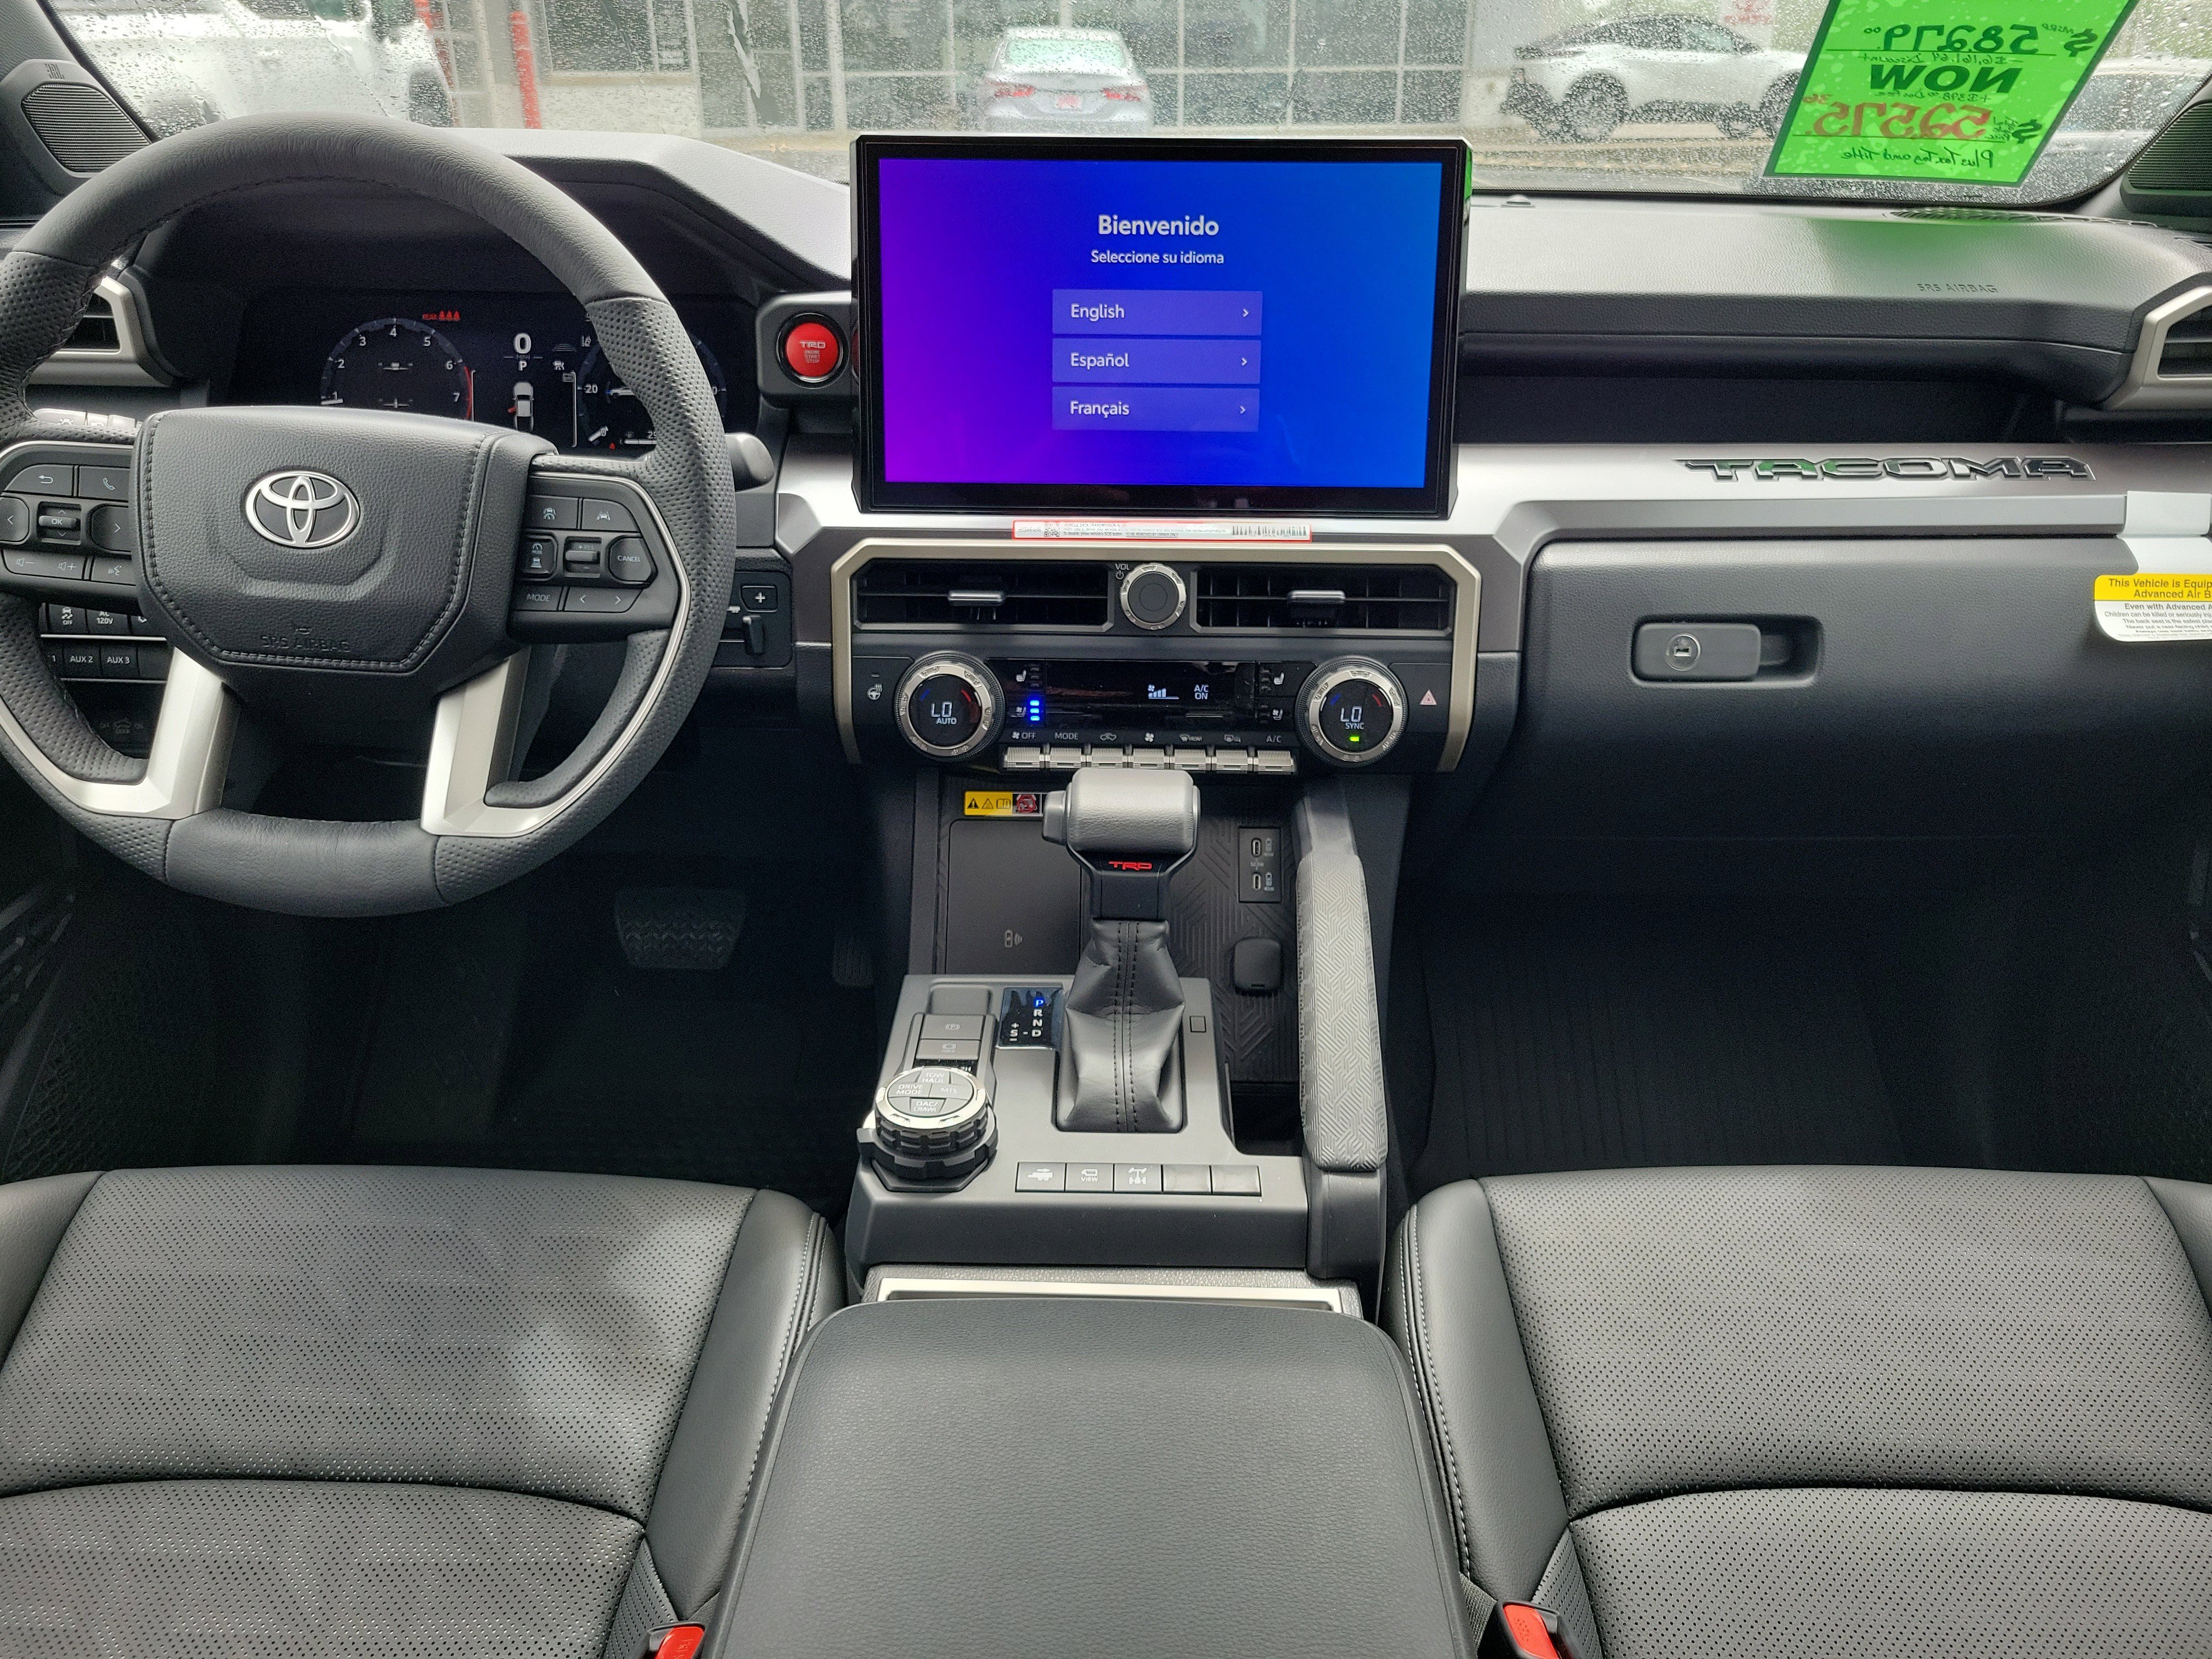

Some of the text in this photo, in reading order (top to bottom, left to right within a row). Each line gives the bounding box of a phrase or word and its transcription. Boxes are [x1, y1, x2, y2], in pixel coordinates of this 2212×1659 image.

[1098, 214, 1220, 236] Bienvenido
[1091, 250, 1224, 264] Seleccione su idioma
[1917, 284, 1999, 292] SRS AIRBAG
[1070, 303, 1125, 322] English
[390, 328, 397, 337] 4
[359, 336, 366, 346] 3
[423, 336, 431, 346] 5
[514, 332, 532, 354] 0
[799, 341, 826, 349] TRD
[337, 359, 345, 369] 2
[445, 360, 454, 370] 6
[518, 360, 527, 371] P
[1070, 352, 1130, 370] Español
[453, 392, 460, 402] 7
[1070, 400, 1130, 419] Français
[1673, 457, 2097, 482] TACOMA
[2108, 578, 2130, 587] This
[2134, 579, 2169, 588] Vehicle
[2172, 579, 2181, 588] is
[527, 594, 551, 602] MODE
[2134, 589, 2183, 598] Advanced
[2187, 590, 2201, 599] Air
[1194, 684, 1209, 692] A/C
[1108, 861, 1152, 871] TRD
[1033, 1009, 1043, 1017] R
[1031, 1029, 1042, 1037] D
